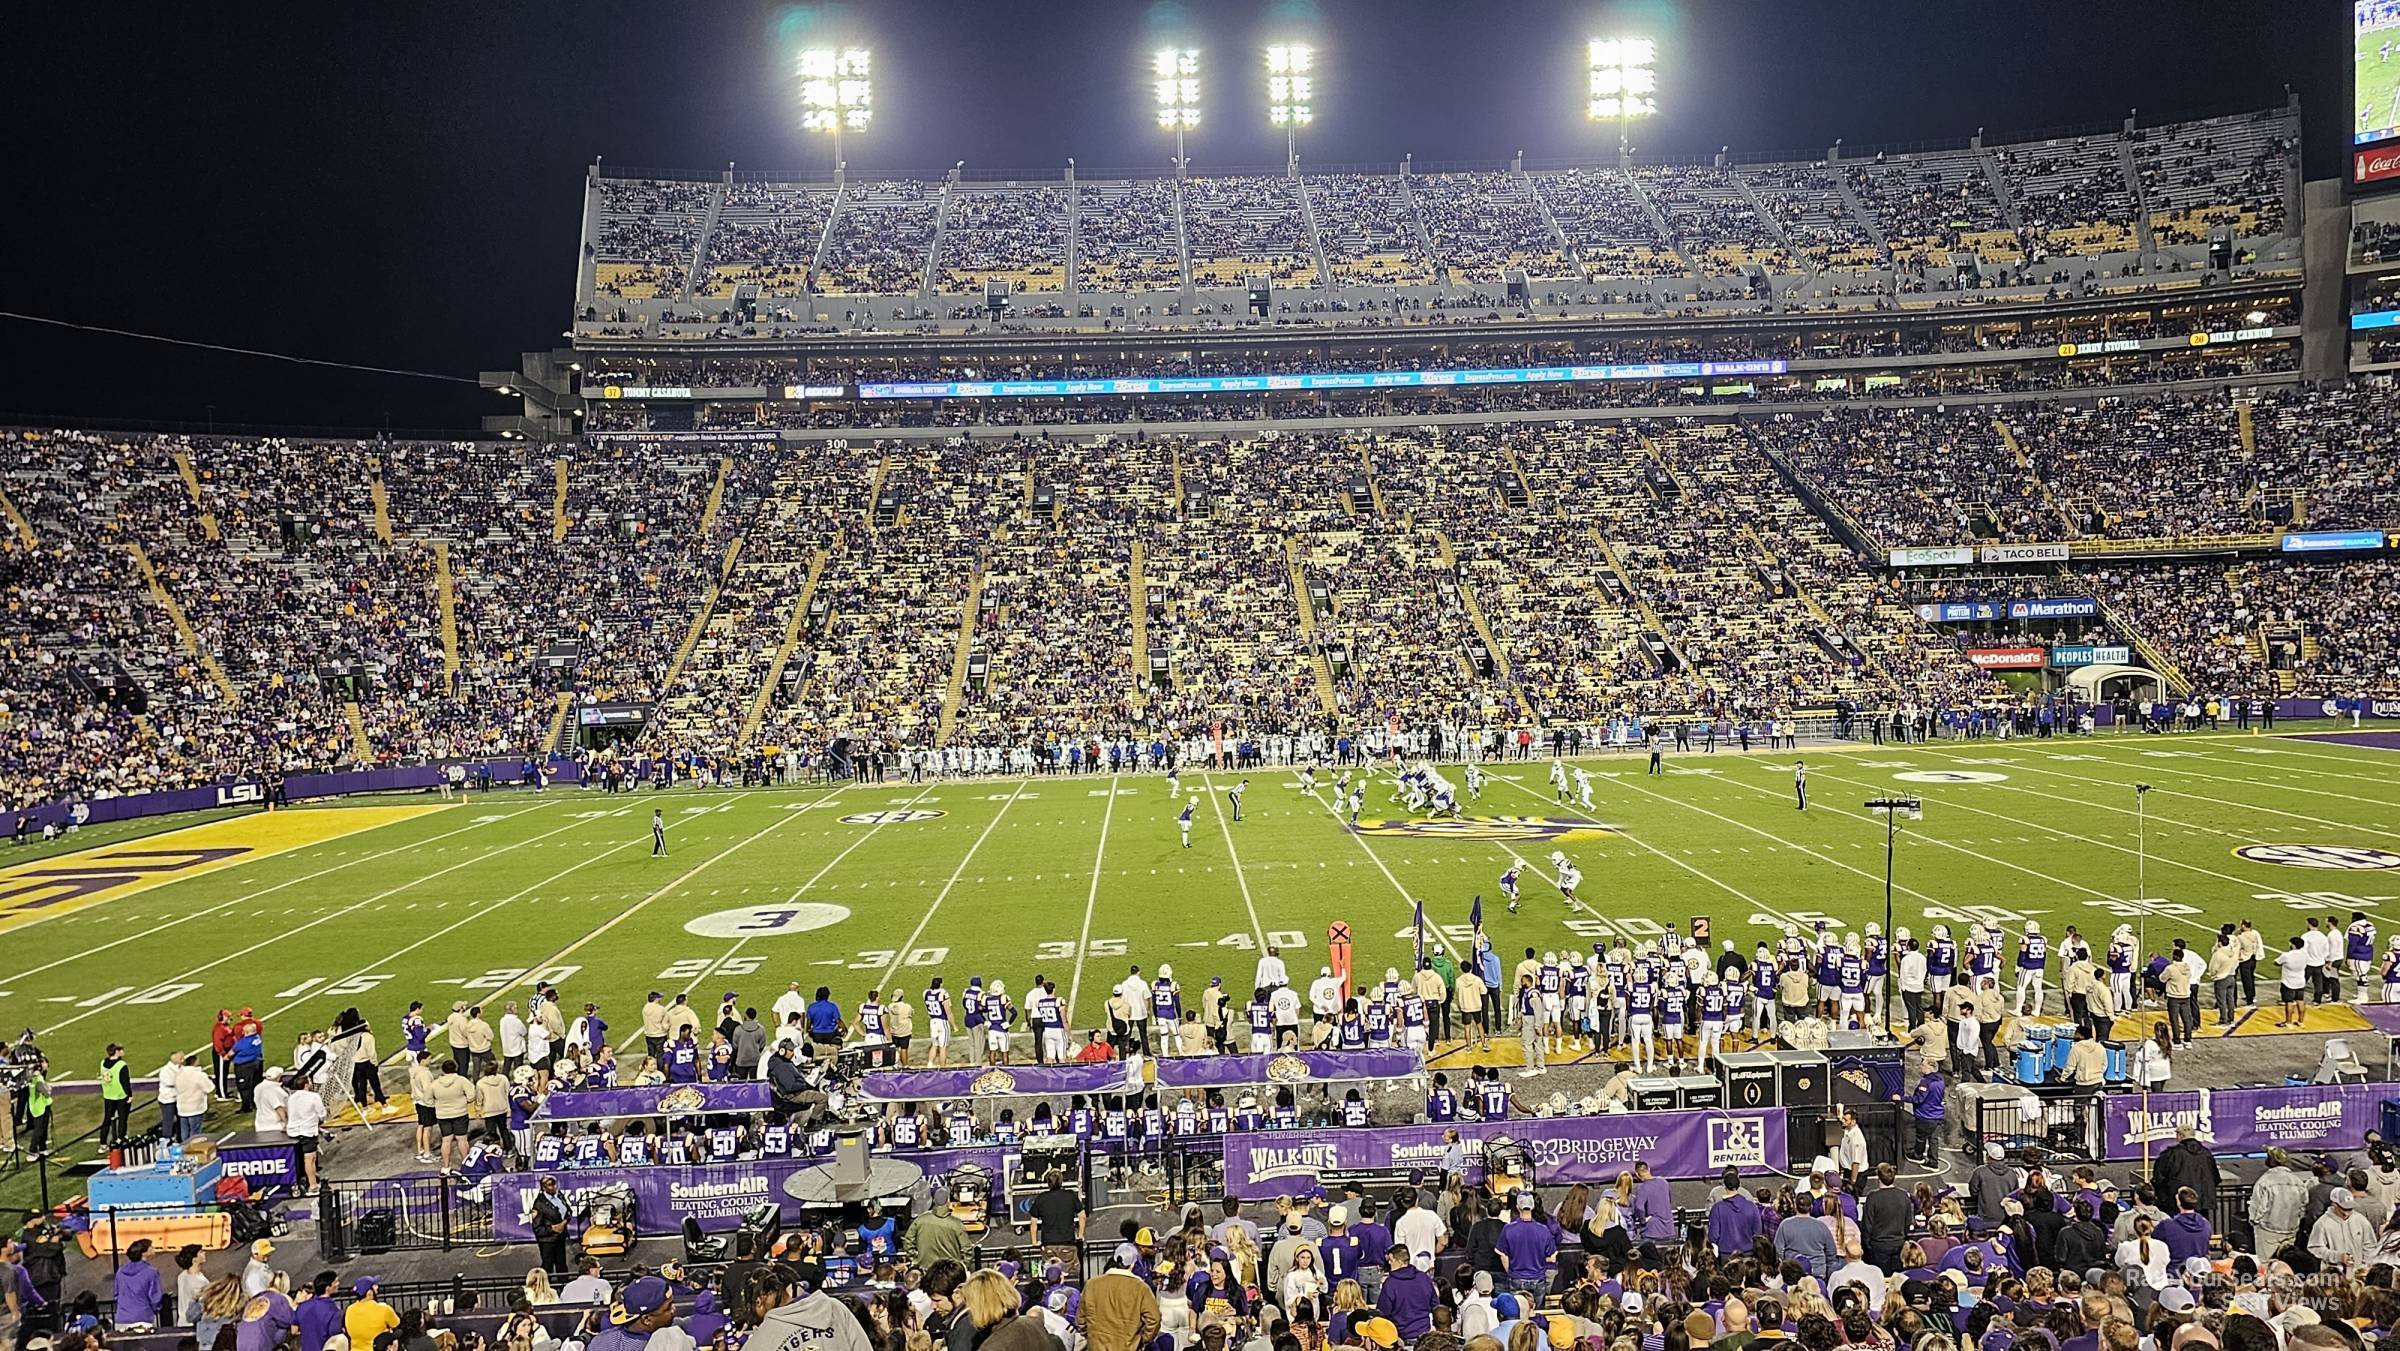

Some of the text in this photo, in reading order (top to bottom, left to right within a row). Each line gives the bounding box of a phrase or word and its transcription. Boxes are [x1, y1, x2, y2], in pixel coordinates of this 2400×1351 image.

[2062, 346, 2073, 355] 21
[1312, 377, 1364, 386] ExpressPros.com
[1372, 374, 1410, 384] Apply Now
[1465, 373, 1519, 381] ExpressPros.com
[1526, 370, 1564, 380] Apply Now
[1003, 384, 1057, 393] ExpressPros.com
[1066, 382, 1104, 392] Apply Now
[1159, 381, 1212, 389] ExpressPros.com
[1220, 379, 1258, 389] Apply Now
[623, 388, 651, 398] TOMMY
[652, 388, 692, 398] CASANOVA
[826, 439, 848, 449] 300
[1906, 549, 1957, 561] EcoSport
[2003, 547, 2065, 559] TACO BELL
[2031, 603, 2094, 615] Marathon
[1972, 652, 2041, 664] McDonald's
[2056, 651, 2127, 663] PEOPLES HEALTH
[217, 784, 264, 804] LSU
[845, 811, 940, 824] SEC
[2081, 899, 2206, 917] 35
[2251, 891, 2380, 909] 30
[1923, 905, 2027, 922] 40
[1562, 918, 1667, 937] 50
[1694, 919, 1709, 937] 2
[1034, 938, 1128, 960] 35
[1216, 931, 1309, 950] 40
[848, 947, 950, 969] 30
[1940, 950, 1950, 963] 2
[656, 956, 769, 979] 25
[1842, 967, 1861, 981] 93
[462, 965, 583, 989] 20
[1541, 975, 1559, 992] 40
[1760, 970, 1771, 986] 6
[75, 983, 204, 1006] 10
[275, 974, 396, 998] 15
[1155, 991, 1172, 1006] 23
[1632, 992, 1651, 1008] 39
[1706, 996, 1723, 1012] 30
[1726, 990, 1744, 1007] 47
[926, 1001, 942, 1017] 38
[987, 1006, 1003, 1021] 21
[1406, 1004, 1424, 1020] 45
[1252, 1010, 1267, 1028] 16
[675, 1048, 694, 1064] 65
[1439, 1094, 1451, 1115] 3
[1487, 1093, 1504, 1112] 17
[2255, 1101, 2342, 1120] SouthernAIR
[1075, 1113, 1087, 1132] 2
[1146, 1116, 1161, 1135] 12
[1212, 1117, 1227, 1133] 14
[1248, 1112, 1255, 1130] 1
[1346, 1108, 1367, 1127] 25
[894, 1123, 916, 1143] 86
[1106, 1117, 1125, 1137] 82
[1178, 1118, 1195, 1136] 19
[2255, 1120, 2342, 1133] HEATING, COOLING
[2270, 1130, 2328, 1140] & PLUMBING
[765, 1133, 788, 1153] 53
[1712, 1120, 1761, 1151] H&E
[537, 1140, 560, 1161] 66
[575, 1139, 598, 1159] 72
[621, 1142, 644, 1163] 69
[712, 1135, 736, 1156] 50
[1557, 1136, 1659, 1156] BRIDGEWAY
[1577, 1150, 1640, 1164] HOSPICE
[1713, 1151, 1760, 1163] RENTALS
[670, 1177, 769, 1199] SouthernAIR
[671, 1196, 769, 1212] HEATING, COOLING
[688, 1210, 696, 1220] &
[1333, 1247, 1340, 1271] 1
